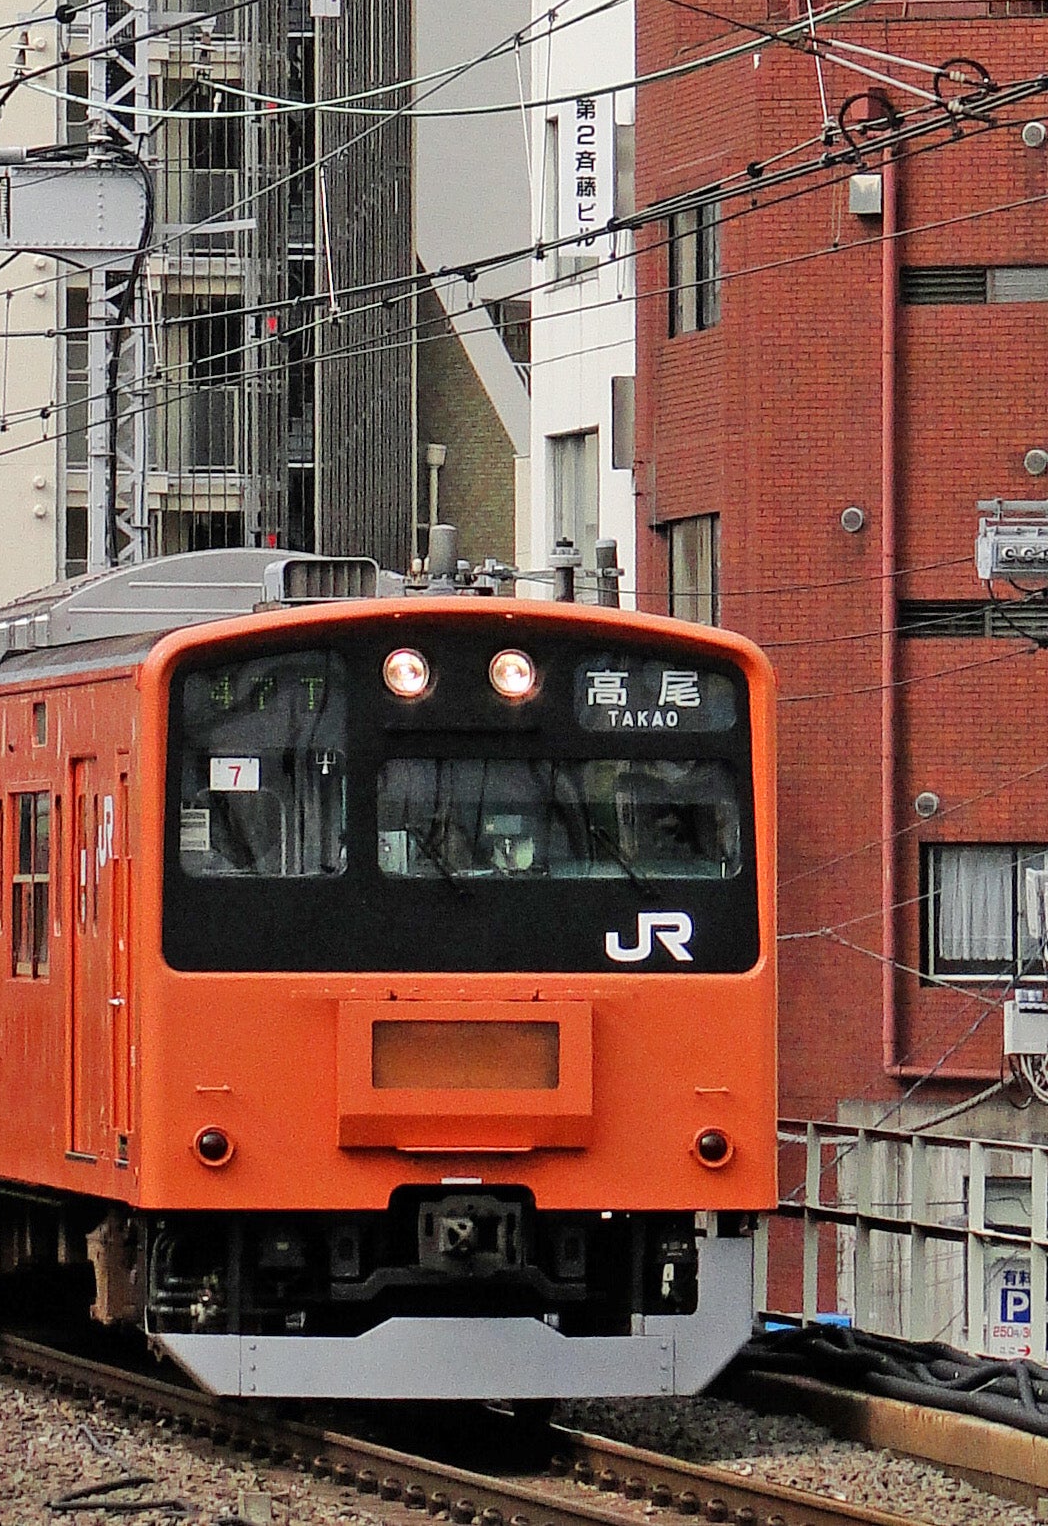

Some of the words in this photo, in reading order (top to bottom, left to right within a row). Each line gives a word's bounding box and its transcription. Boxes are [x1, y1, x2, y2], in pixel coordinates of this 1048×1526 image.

[586, 669, 701, 707] 高尾
[607, 710, 679, 727] TAKAO
[228, 766, 241, 787] 7
[98, 795, 113, 867] JR
[605, 912, 694, 961] JR
[1006, 1290, 1030, 1321] P
